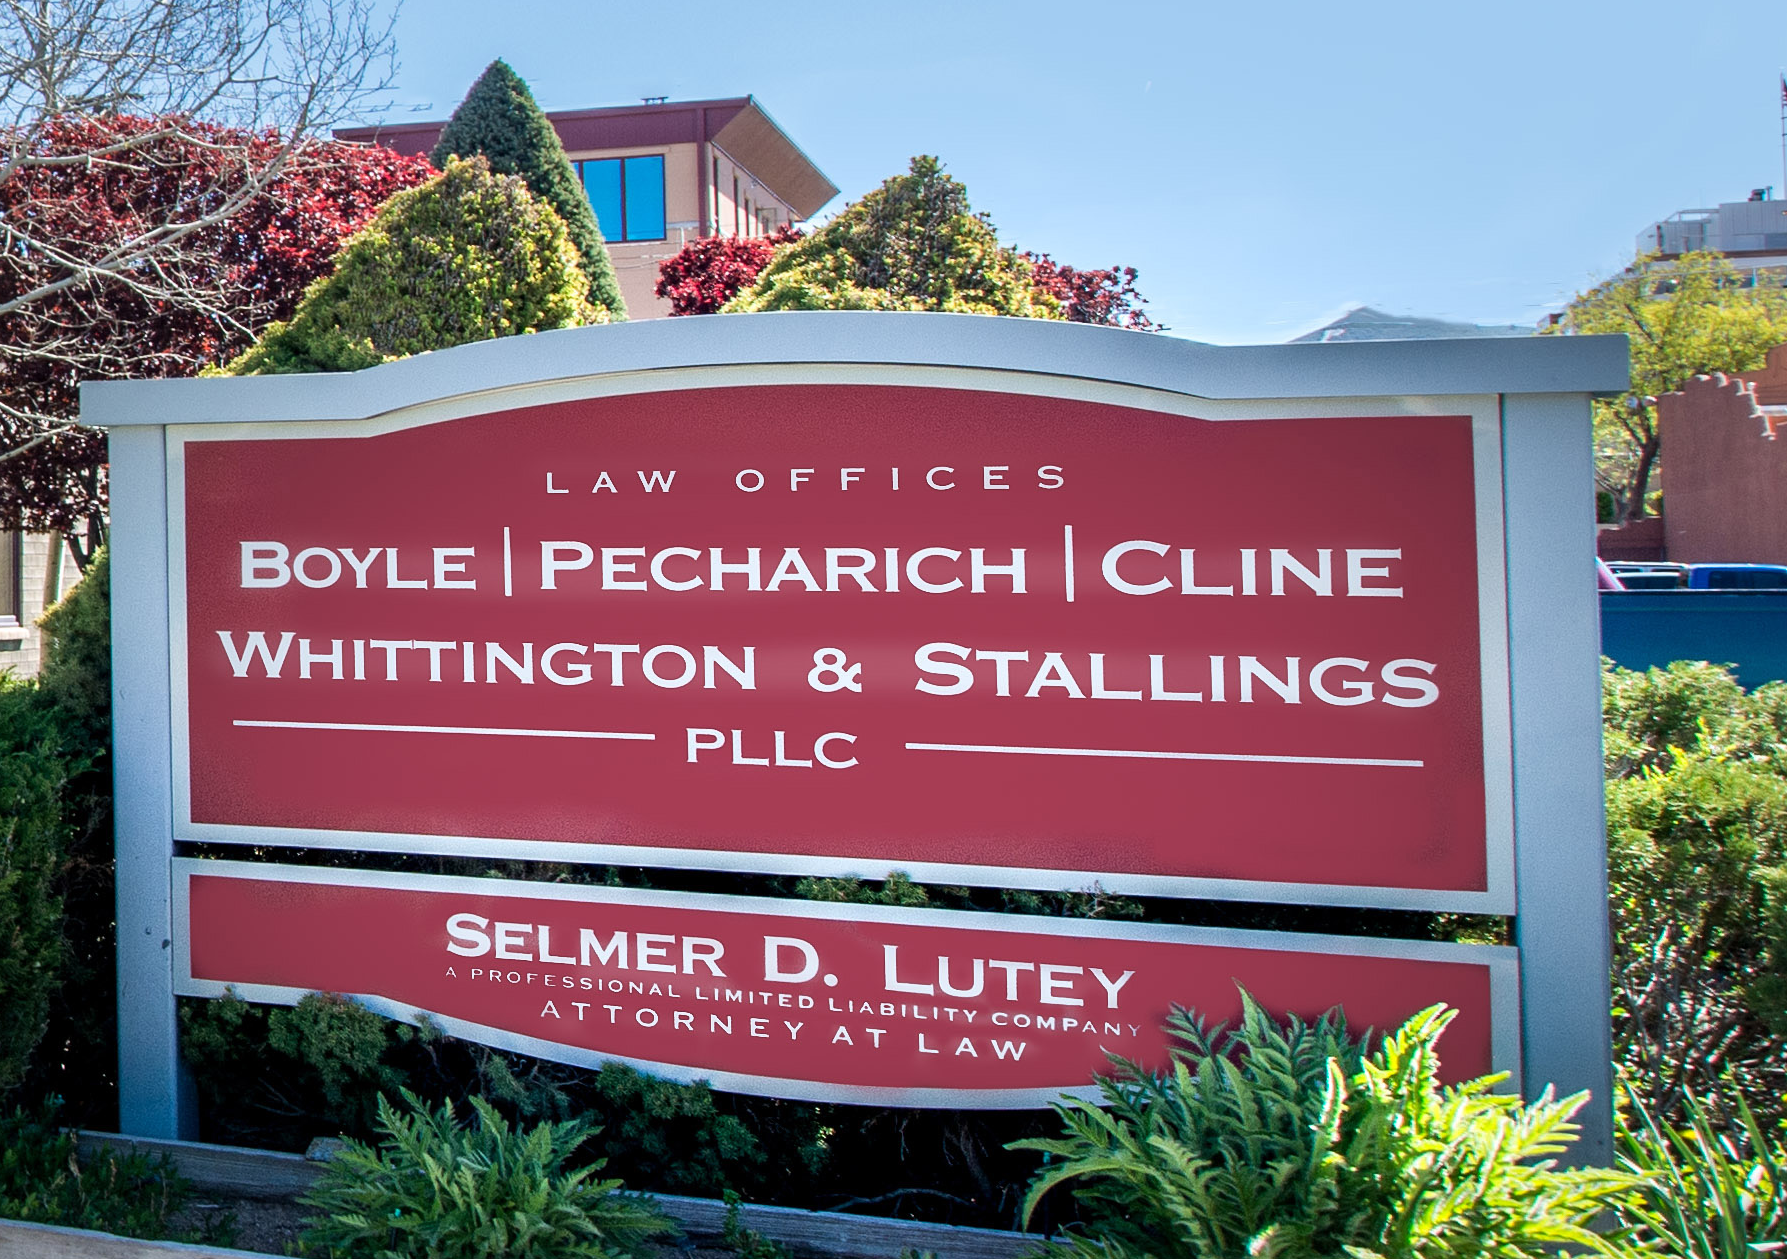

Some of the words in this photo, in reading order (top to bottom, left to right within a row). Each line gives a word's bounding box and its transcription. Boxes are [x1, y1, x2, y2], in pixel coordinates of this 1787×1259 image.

[546, 471, 677, 494] LAW
[735, 465, 1065, 493] OFFICES
[239, 541, 477, 591] BOYLE
[539, 540, 1029, 595] PECHARICH
[1101, 539, 1405, 598] CLINE
[215, 630, 757, 691] WHITTINGTON
[807, 647, 864, 694] &
[914, 642, 1441, 709] STALLINGS
[686, 727, 860, 769] PLLC
[445, 912, 728, 979] SELMER
[763, 935, 839, 988] D.
[882, 944, 1137, 1010] LUTEY
[445, 966, 458, 979] A
[471, 968, 681, 999] PROFESSIONAL
[695, 986, 815, 1010] LIMITED
[828, 997, 978, 1025] LIABILITY
[991, 1011, 1141, 1039] COMPANY
[540, 1000, 805, 1042] ATTORNEY
[831, 1025, 888, 1049] AT
[918, 1032, 1028, 1062] LAW
